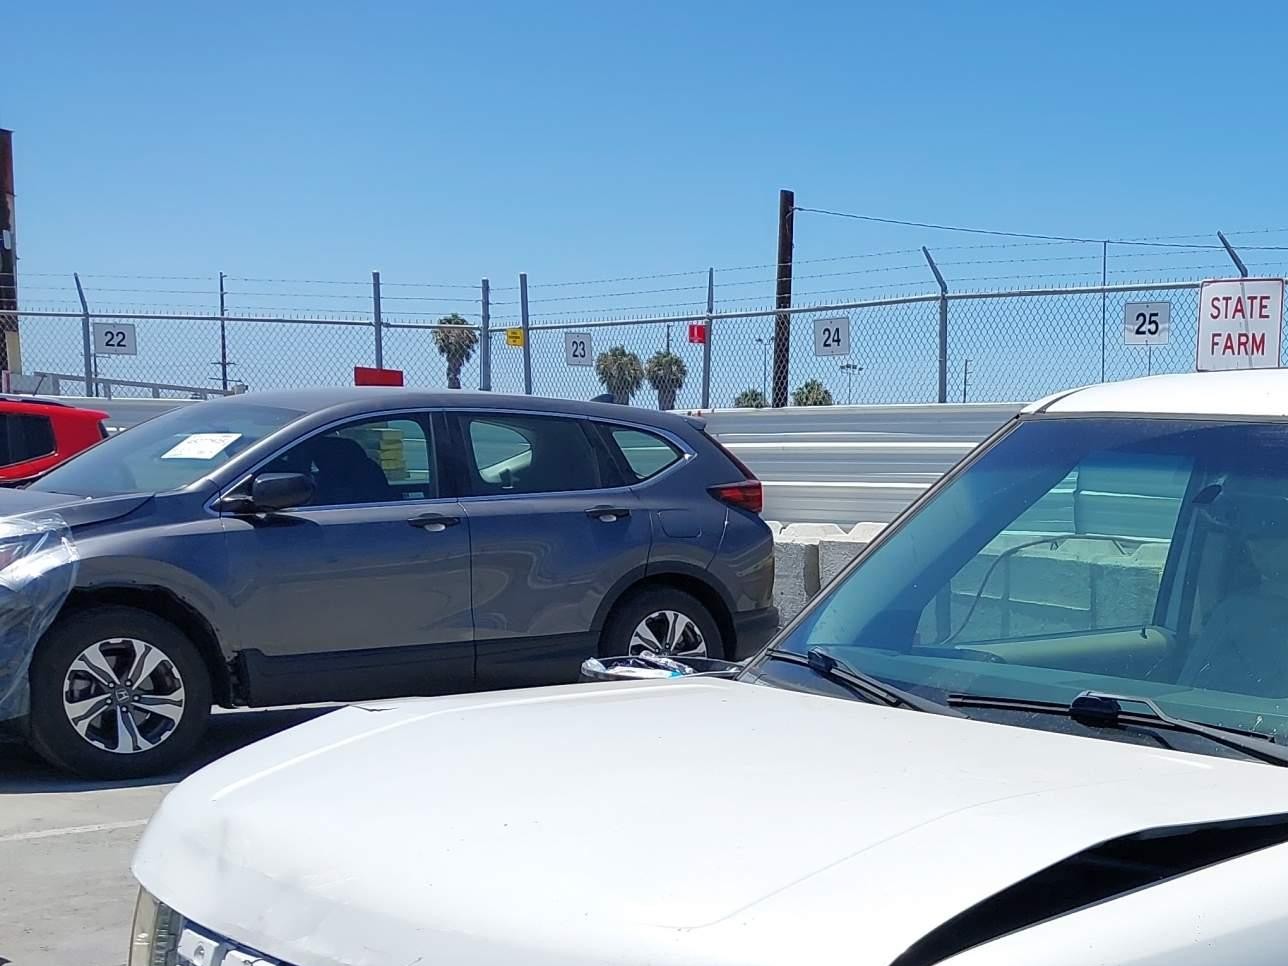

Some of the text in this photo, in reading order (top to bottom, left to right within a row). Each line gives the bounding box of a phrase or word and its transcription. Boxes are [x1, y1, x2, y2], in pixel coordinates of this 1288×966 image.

[1210, 296, 1271, 320] STATE
[1135, 312, 1159, 336] 25
[104, 331, 127, 347] 22
[823, 327, 841, 347] 24
[1211, 332, 1265, 356] FARM
[572, 340, 586, 358] 23
